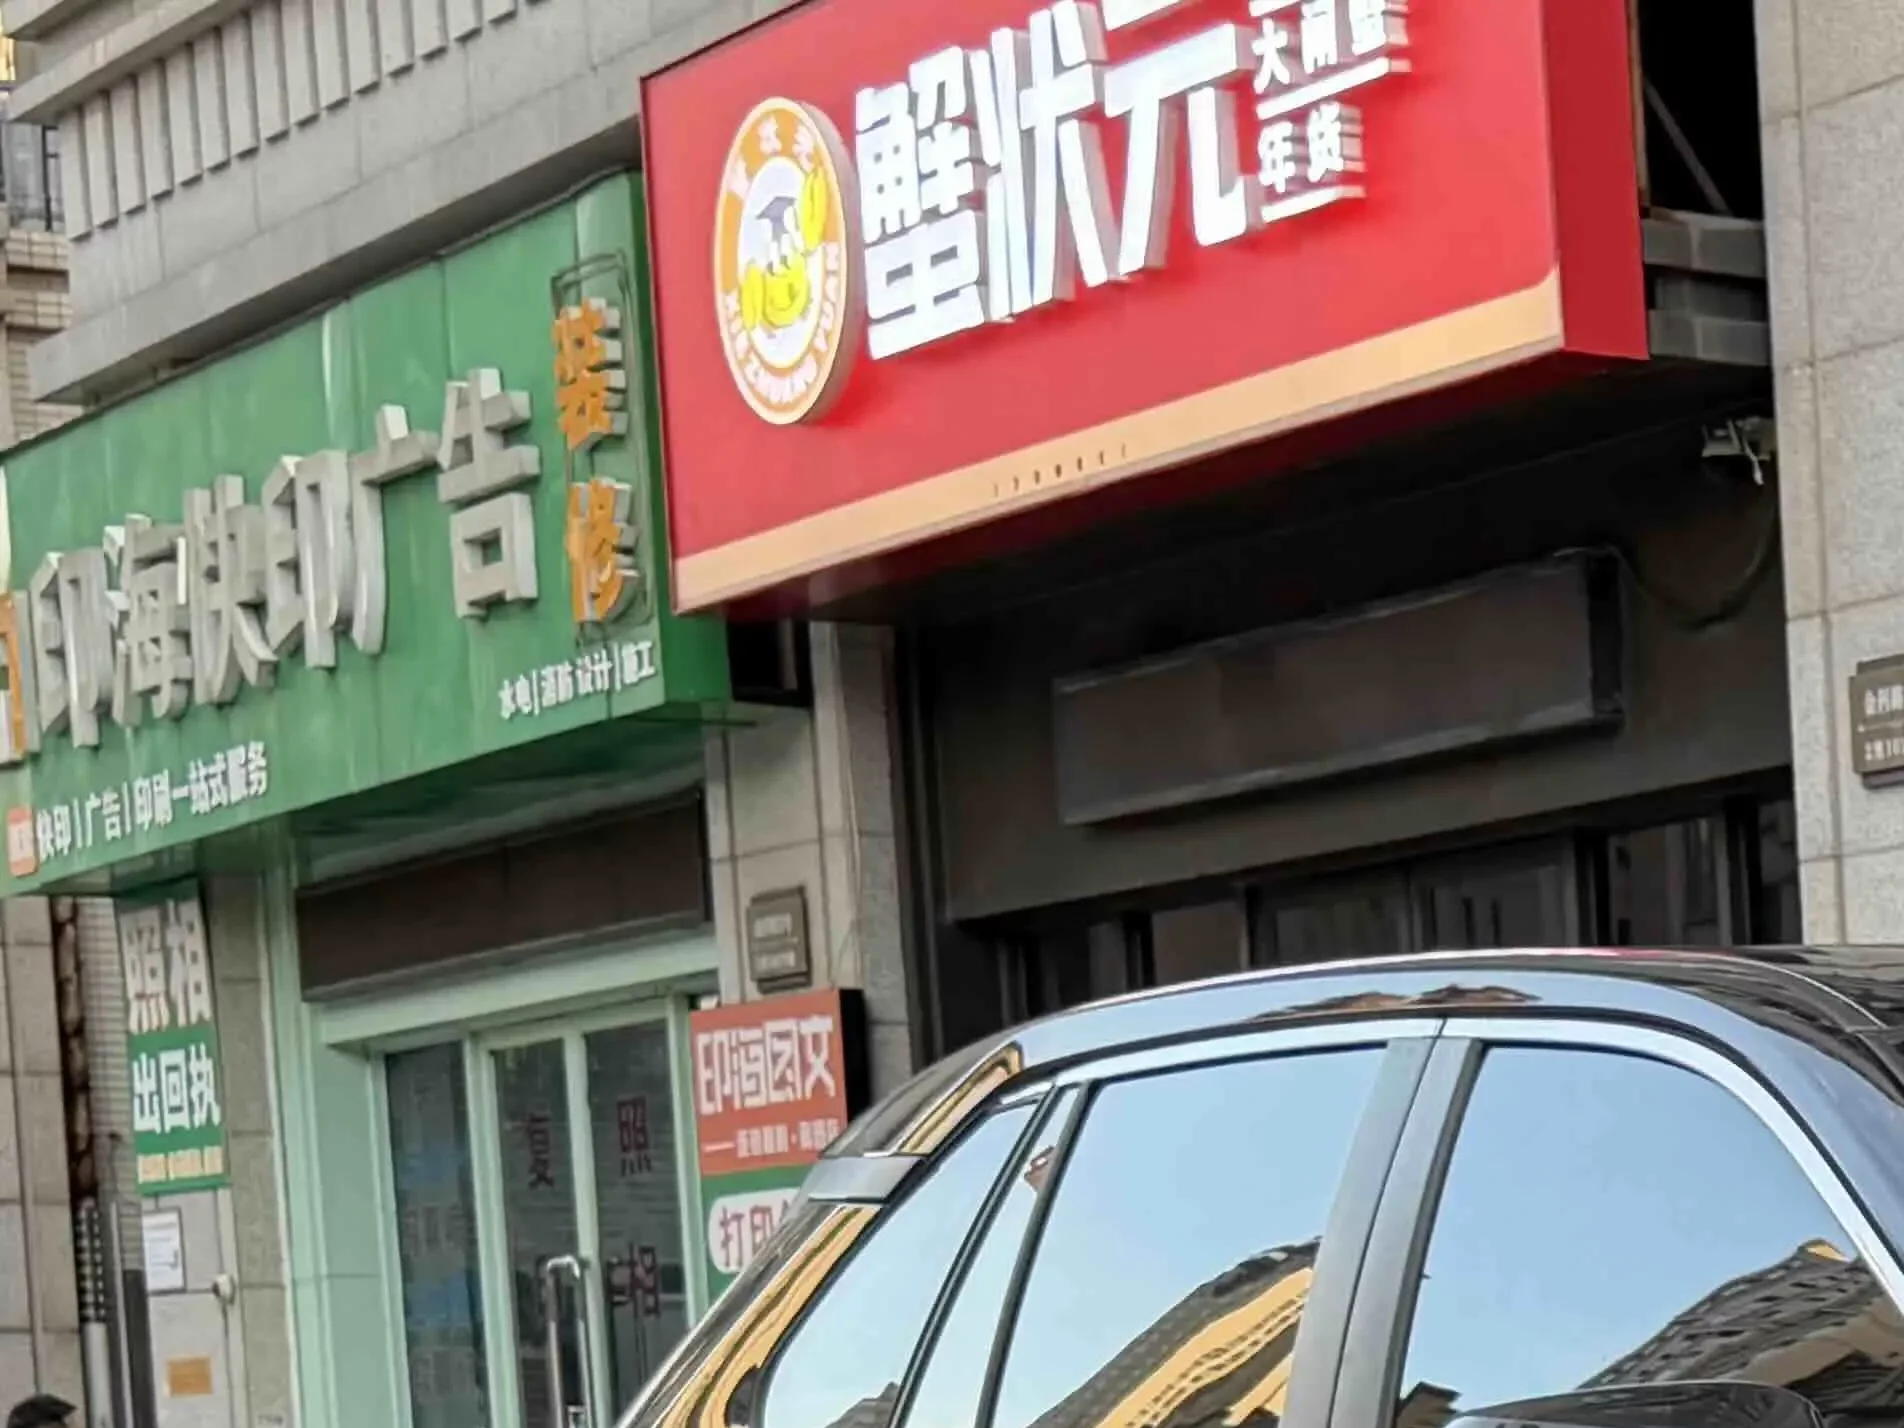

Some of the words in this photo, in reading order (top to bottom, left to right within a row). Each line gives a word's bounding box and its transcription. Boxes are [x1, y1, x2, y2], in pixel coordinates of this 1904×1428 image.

[853, 0, 1255, 360] 蟹状元
[1258, 101, 1345, 192] 年货
[552, 298, 637, 624] 装修
[120, 899, 211, 1034] 照相
[132, 1041, 222, 1135] 出回执
[720, 1200, 789, 1267] 打印
